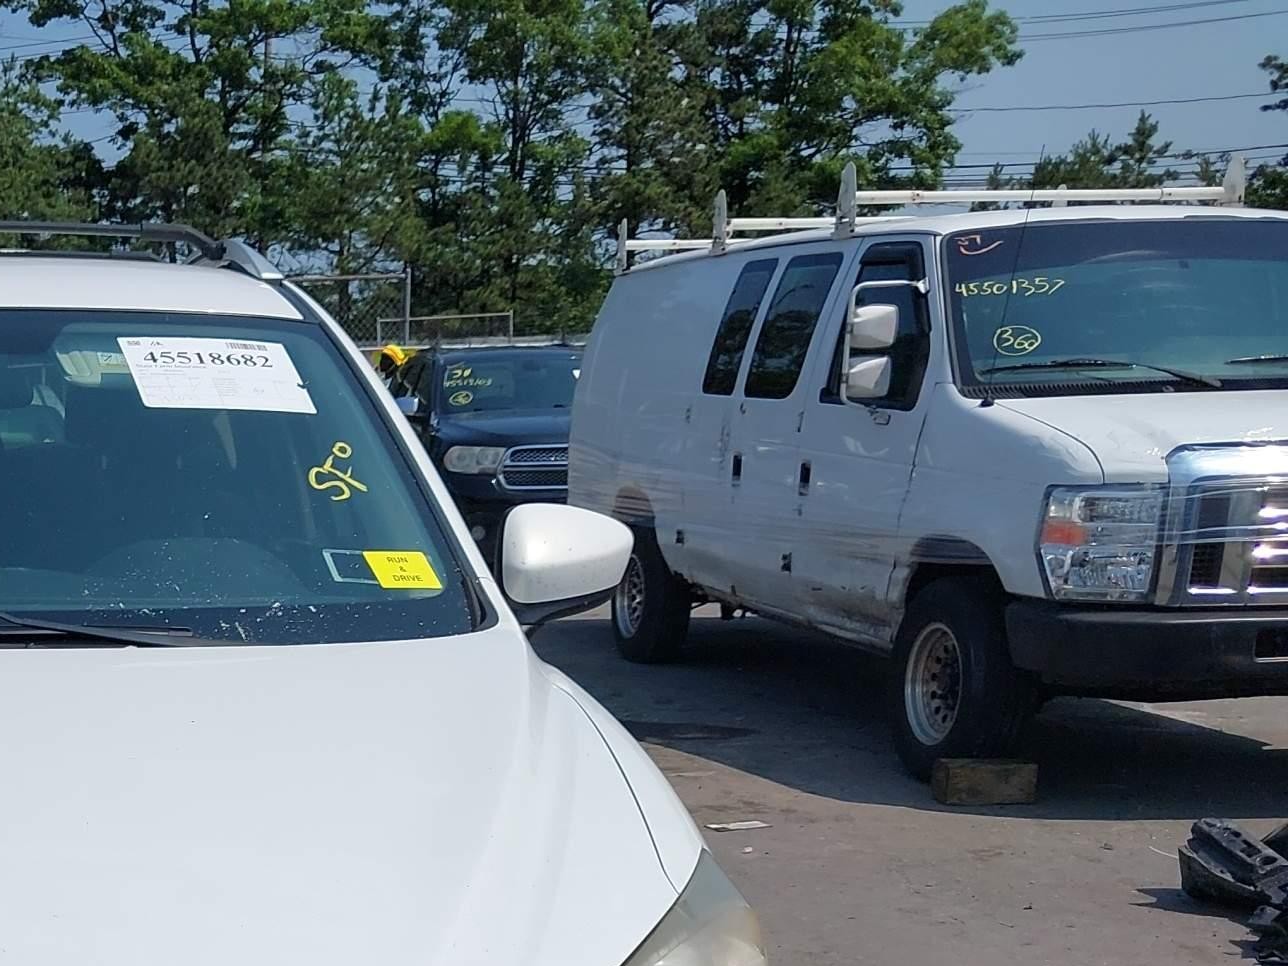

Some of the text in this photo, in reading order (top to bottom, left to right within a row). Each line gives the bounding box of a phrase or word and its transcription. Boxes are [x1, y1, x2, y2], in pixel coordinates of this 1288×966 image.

[954, 277, 1065, 297] 45501357
[143, 351, 273, 369] 45518682
[386, 556, 409, 564] RUN
[399, 565, 407, 573] &
[392, 574, 424, 583] DRIVE
